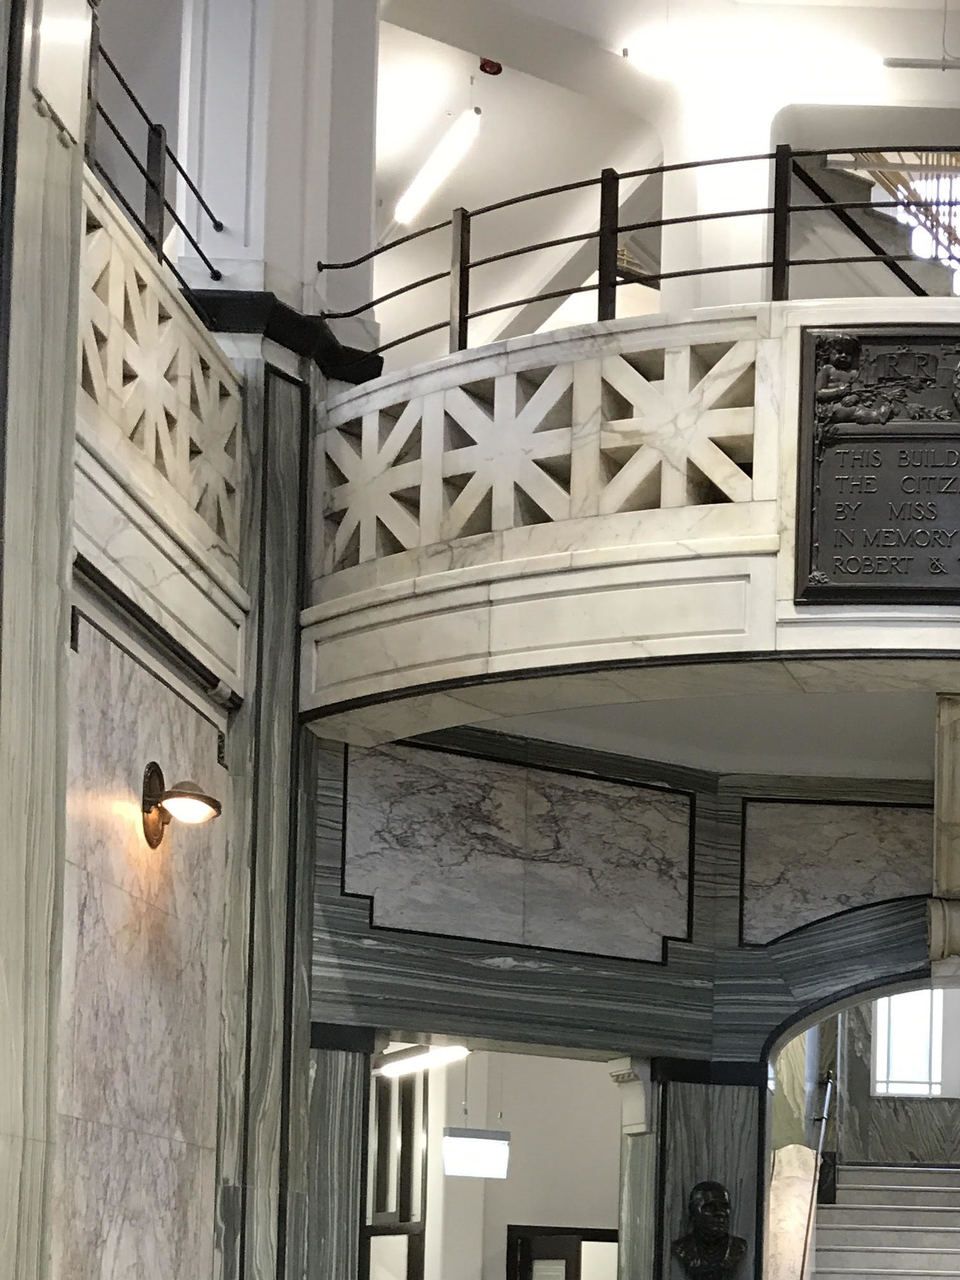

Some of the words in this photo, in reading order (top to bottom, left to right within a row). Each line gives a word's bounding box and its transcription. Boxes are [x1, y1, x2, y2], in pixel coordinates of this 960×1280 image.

[835, 449, 882, 468] THIS
[835, 475, 878, 494] THE
[834, 502, 862, 520] BY
[888, 502, 937, 521] MISS
[833, 528, 855, 548] IN
[863, 528, 958, 548] MEMORY
[832, 555, 915, 575] ROBERT
[928, 556, 949, 575] &
